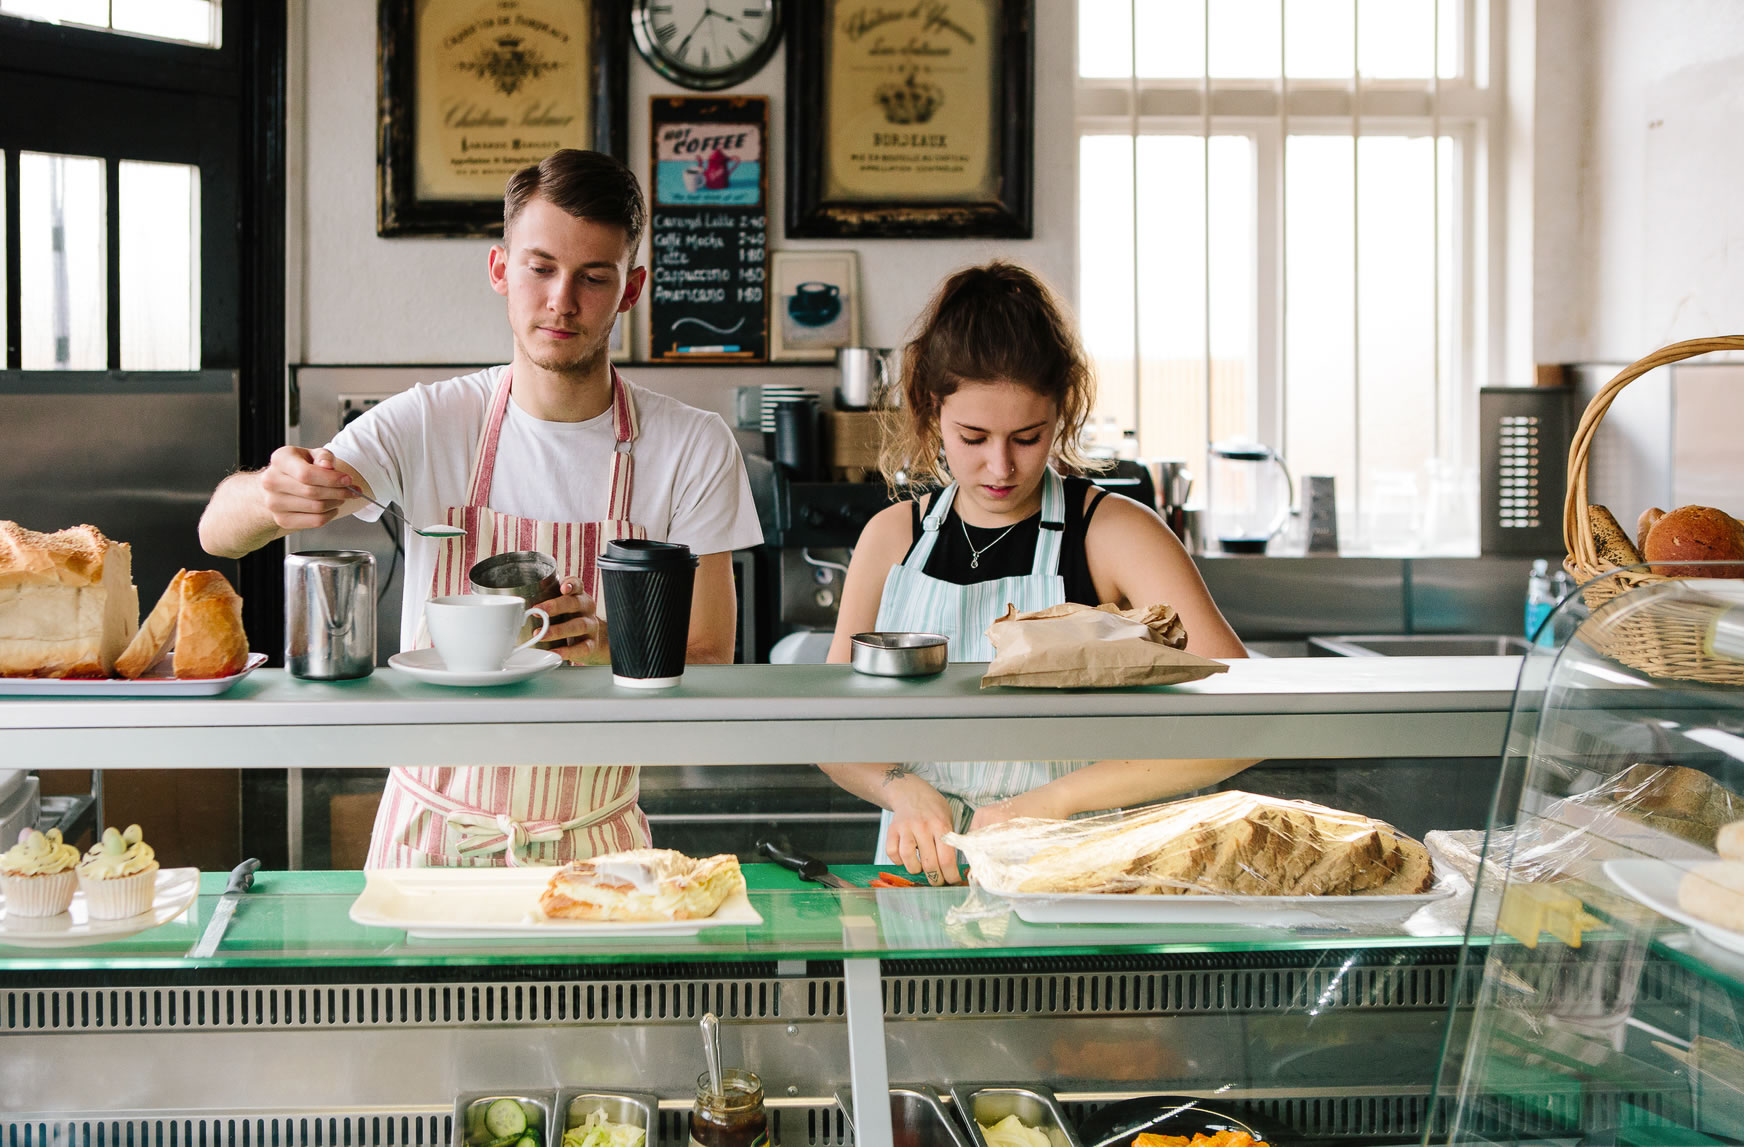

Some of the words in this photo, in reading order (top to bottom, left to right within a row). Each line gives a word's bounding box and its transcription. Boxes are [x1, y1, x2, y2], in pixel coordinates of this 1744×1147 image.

[664, 128, 692, 141] HOT
[673, 132, 748, 155] COFFEE
[704, 213, 735, 228] Latte
[685, 232, 724, 250] Mocha
[655, 251, 689, 266] Latte
[654, 266, 730, 287] Cappuccino
[653, 285, 726, 304] Americano
